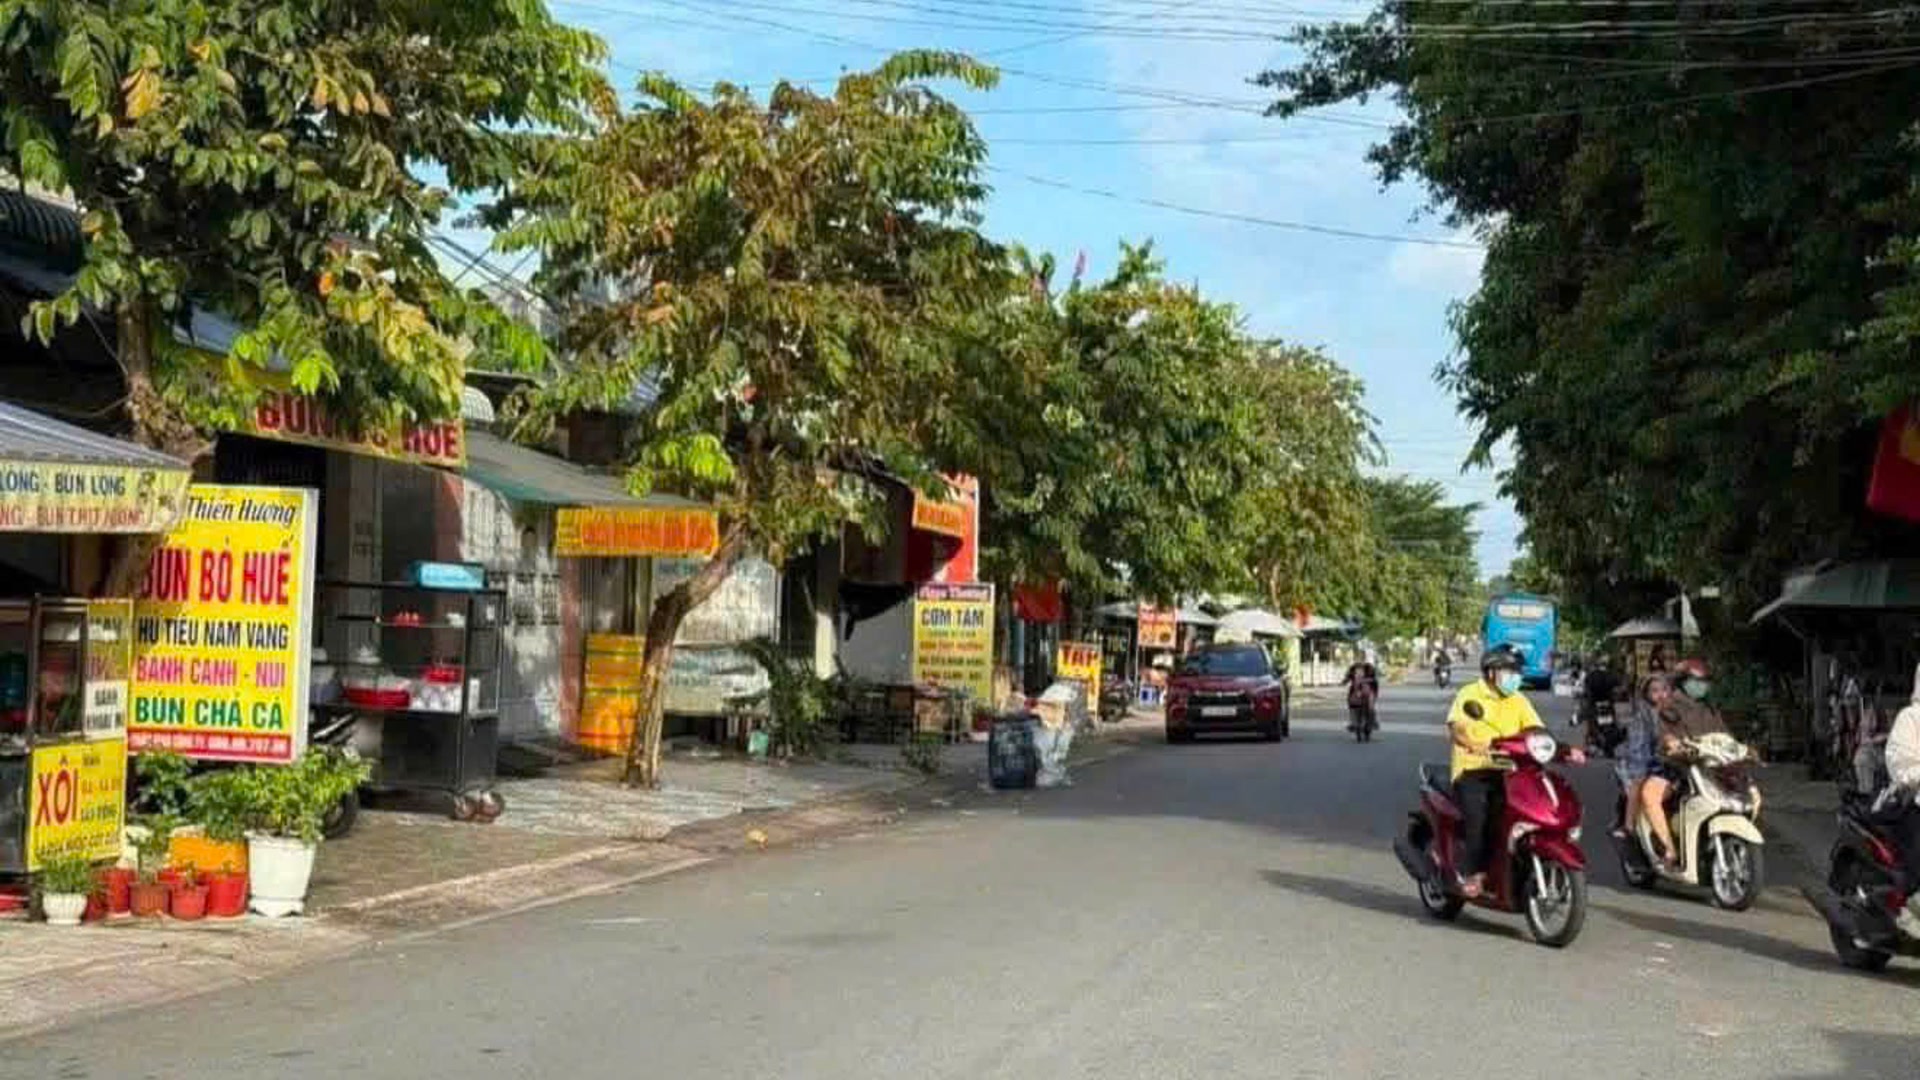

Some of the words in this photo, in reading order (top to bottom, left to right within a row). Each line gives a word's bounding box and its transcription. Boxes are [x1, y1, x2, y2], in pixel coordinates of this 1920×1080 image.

[242, 534, 291, 606] HUẾ
[204, 620, 241, 648] NAM
[247, 622, 289, 650] VANG
[190, 656, 238, 686] CANH
[256, 662, 286, 689] NUI
[35, 755, 79, 827] XÔI
